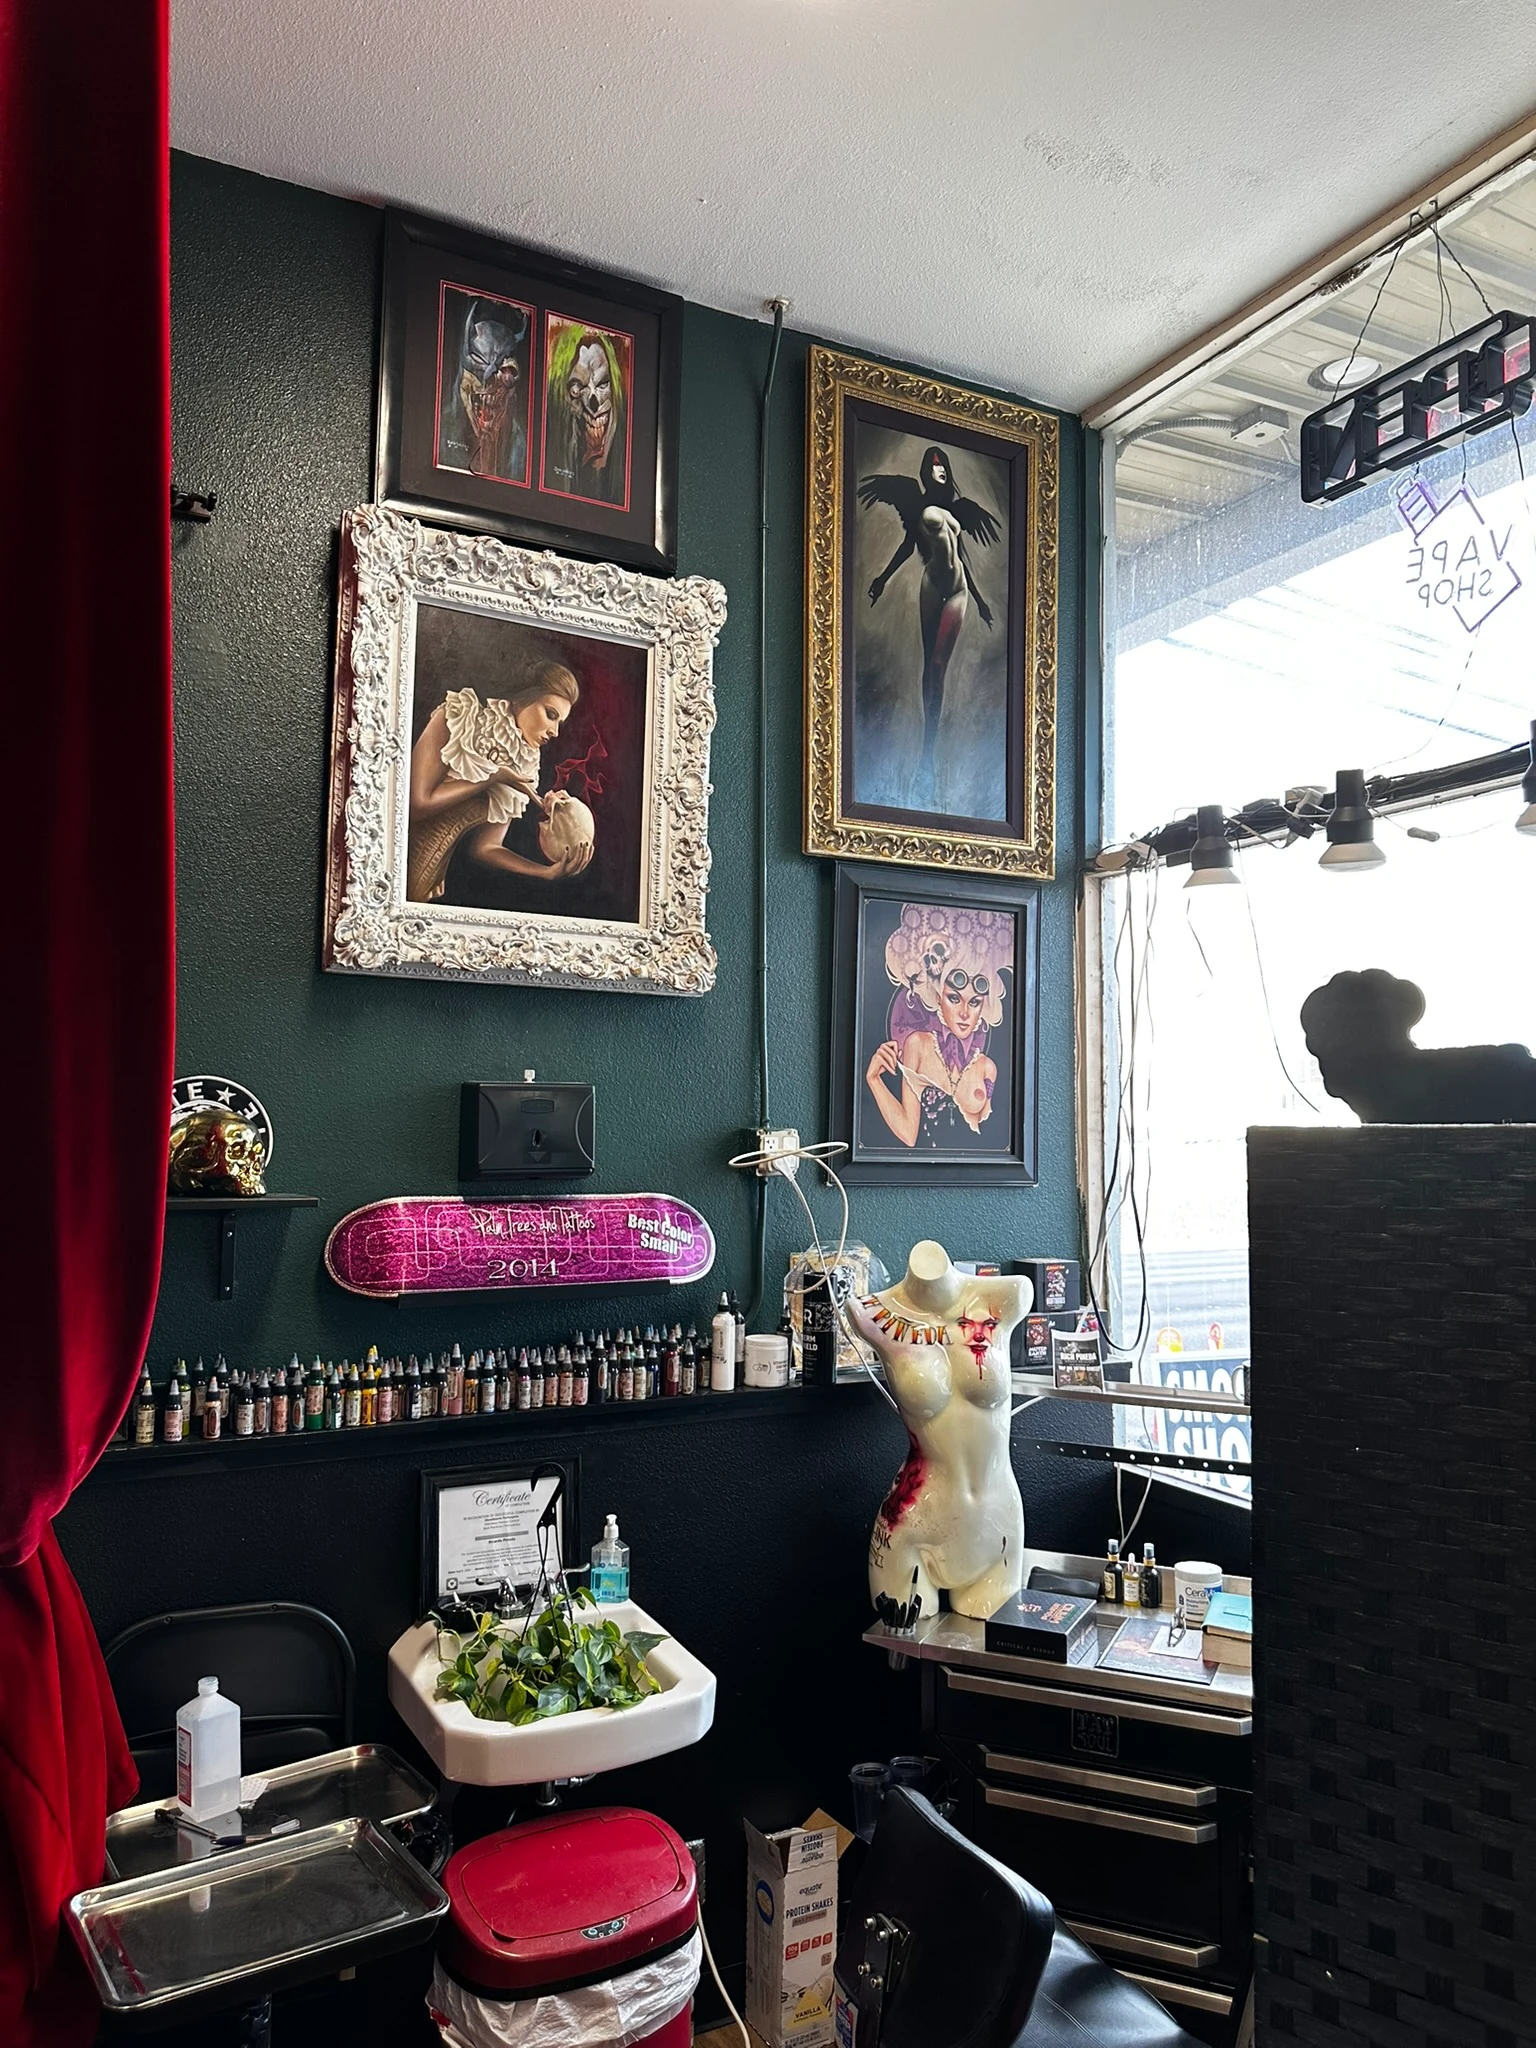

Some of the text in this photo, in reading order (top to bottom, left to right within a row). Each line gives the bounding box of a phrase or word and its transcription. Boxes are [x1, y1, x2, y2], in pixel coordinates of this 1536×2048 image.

[550, 1207, 596, 1235] Tattoos
[628, 1212, 693, 1246] Best Color
[640, 1232, 679, 1255] Small
[487, 1258, 560, 1279] 2014
[1166, 1368, 1249, 1424] SMO
[1174, 1426, 1251, 1492] SHO
[472, 1490, 531, 1509] Certificate
[799, 1883, 823, 1895] equate
[785, 1897, 834, 1919] PROTEIN SHAKES
[795, 2006, 821, 2018] VANILLA
